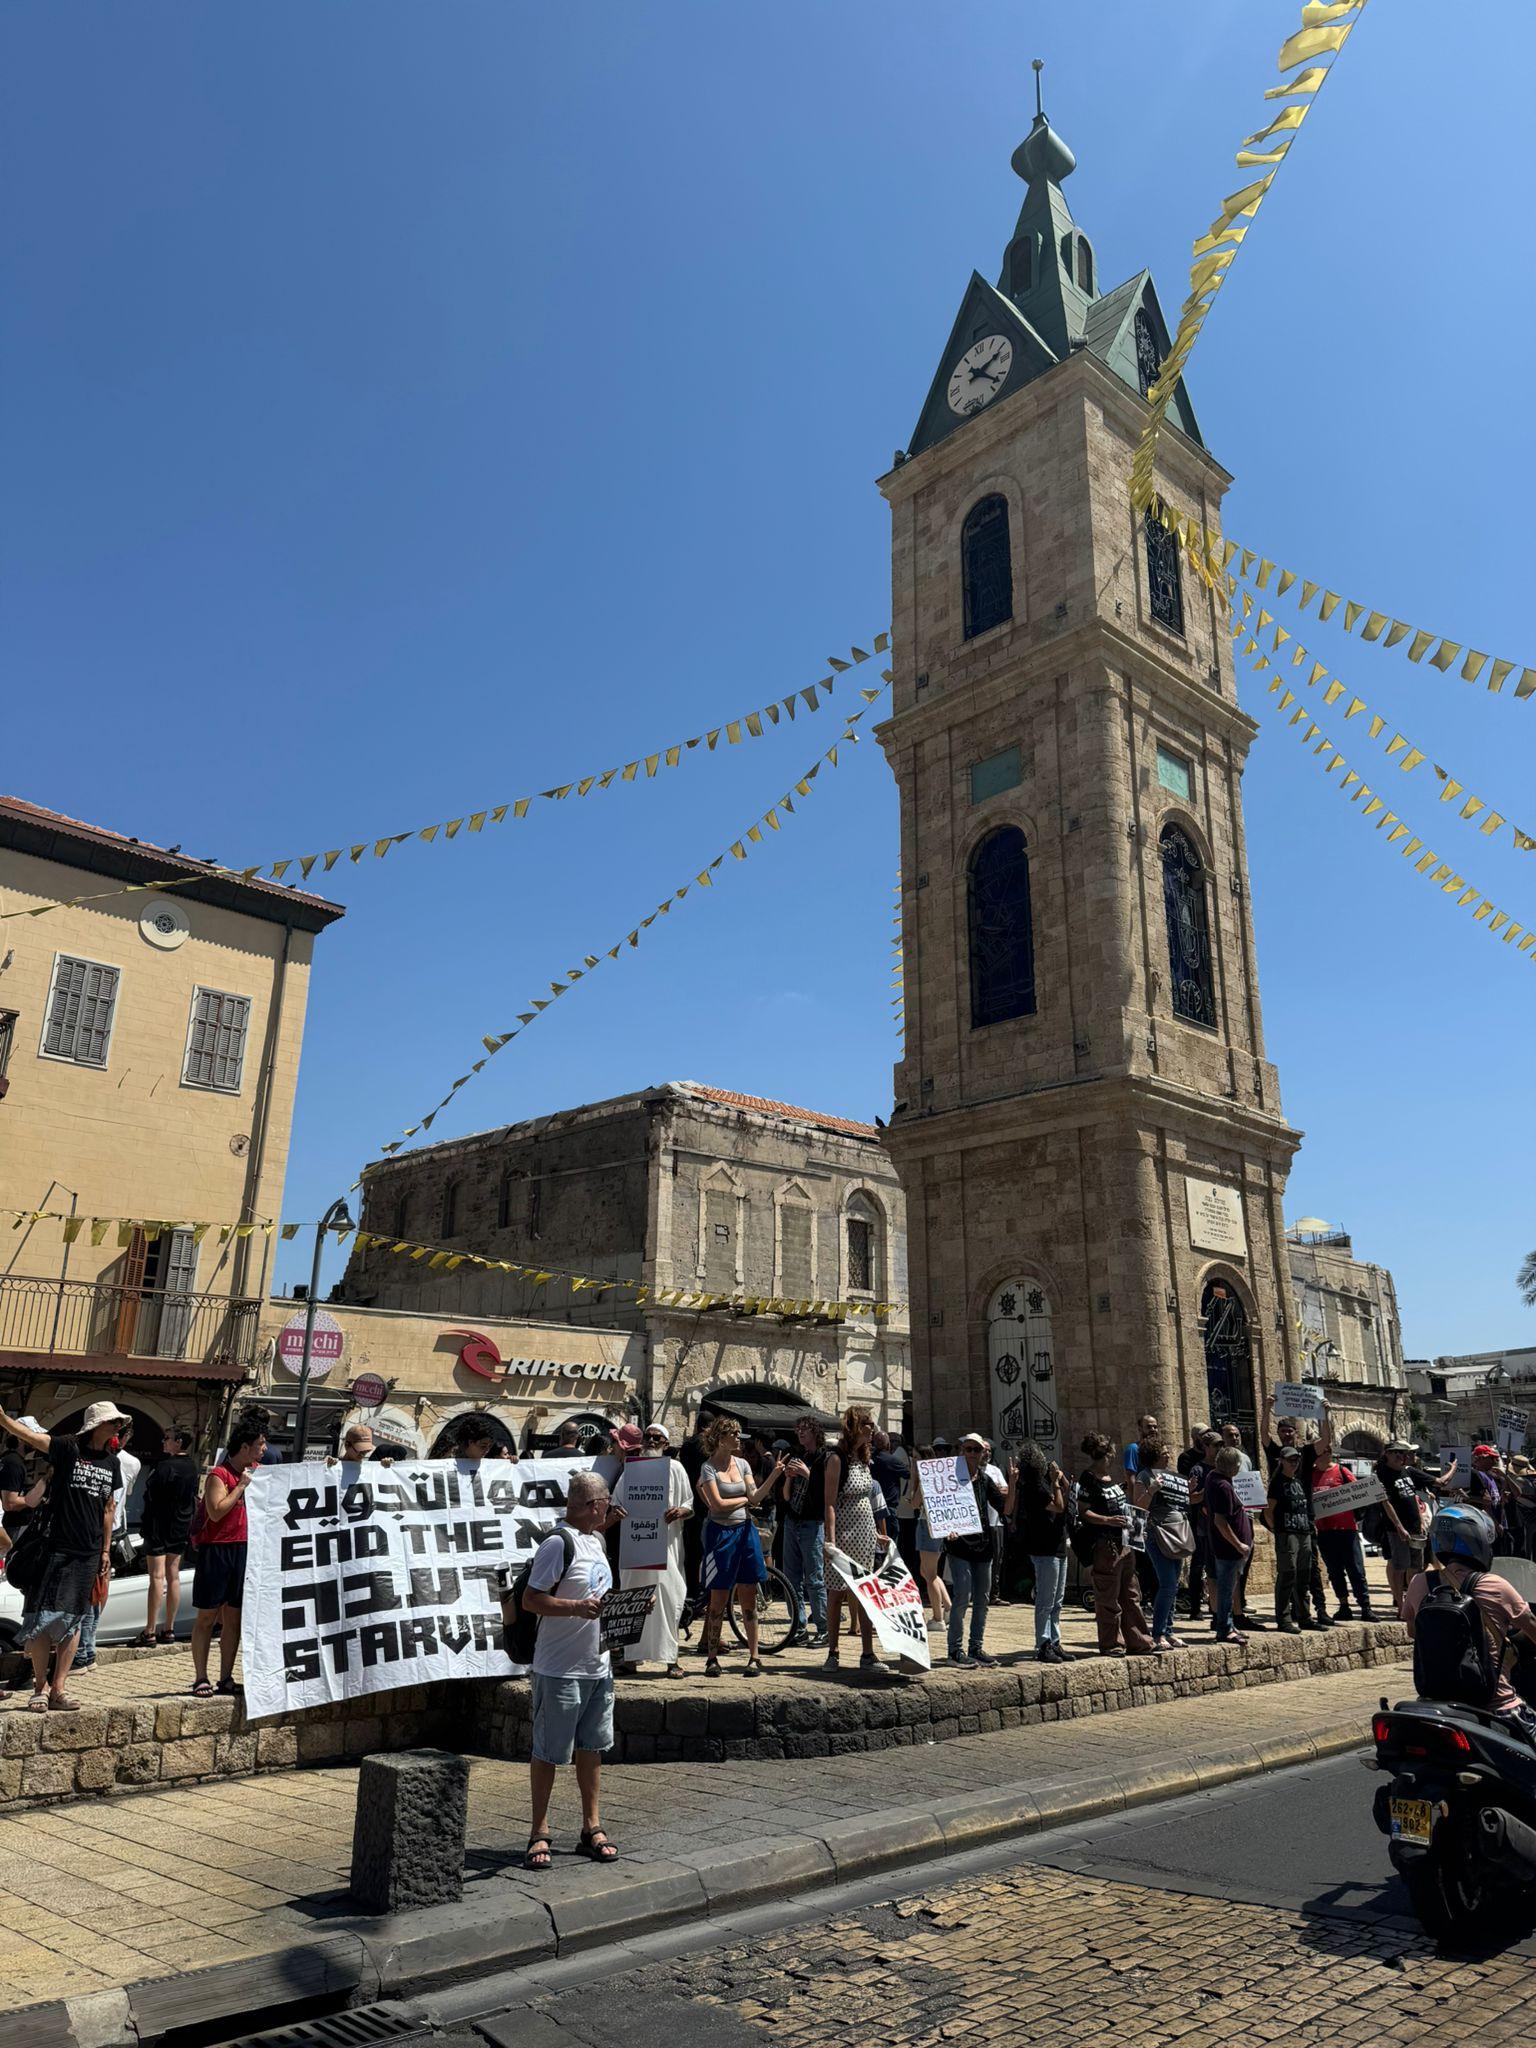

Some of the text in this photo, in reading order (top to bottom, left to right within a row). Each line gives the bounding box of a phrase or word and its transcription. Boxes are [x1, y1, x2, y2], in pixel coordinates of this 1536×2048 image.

[286, 1334, 339, 1350] mchi
[920, 1458, 955, 1476] STOP
[282, 1470, 462, 1531] التجويع
[628, 1492, 664, 1501] המלחמה
[924, 1494, 962, 1510] ISRAEL
[928, 1504, 977, 1524] GENOCIDE
[630, 1518, 659, 1531] أوقفوا
[281, 1525, 390, 1572] END
[400, 1519, 504, 1555] THE
[602, 1587, 655, 1604] STOP GAZ
[601, 1601, 647, 1618] ENOCID
[283, 1613, 505, 1684] STARVA
